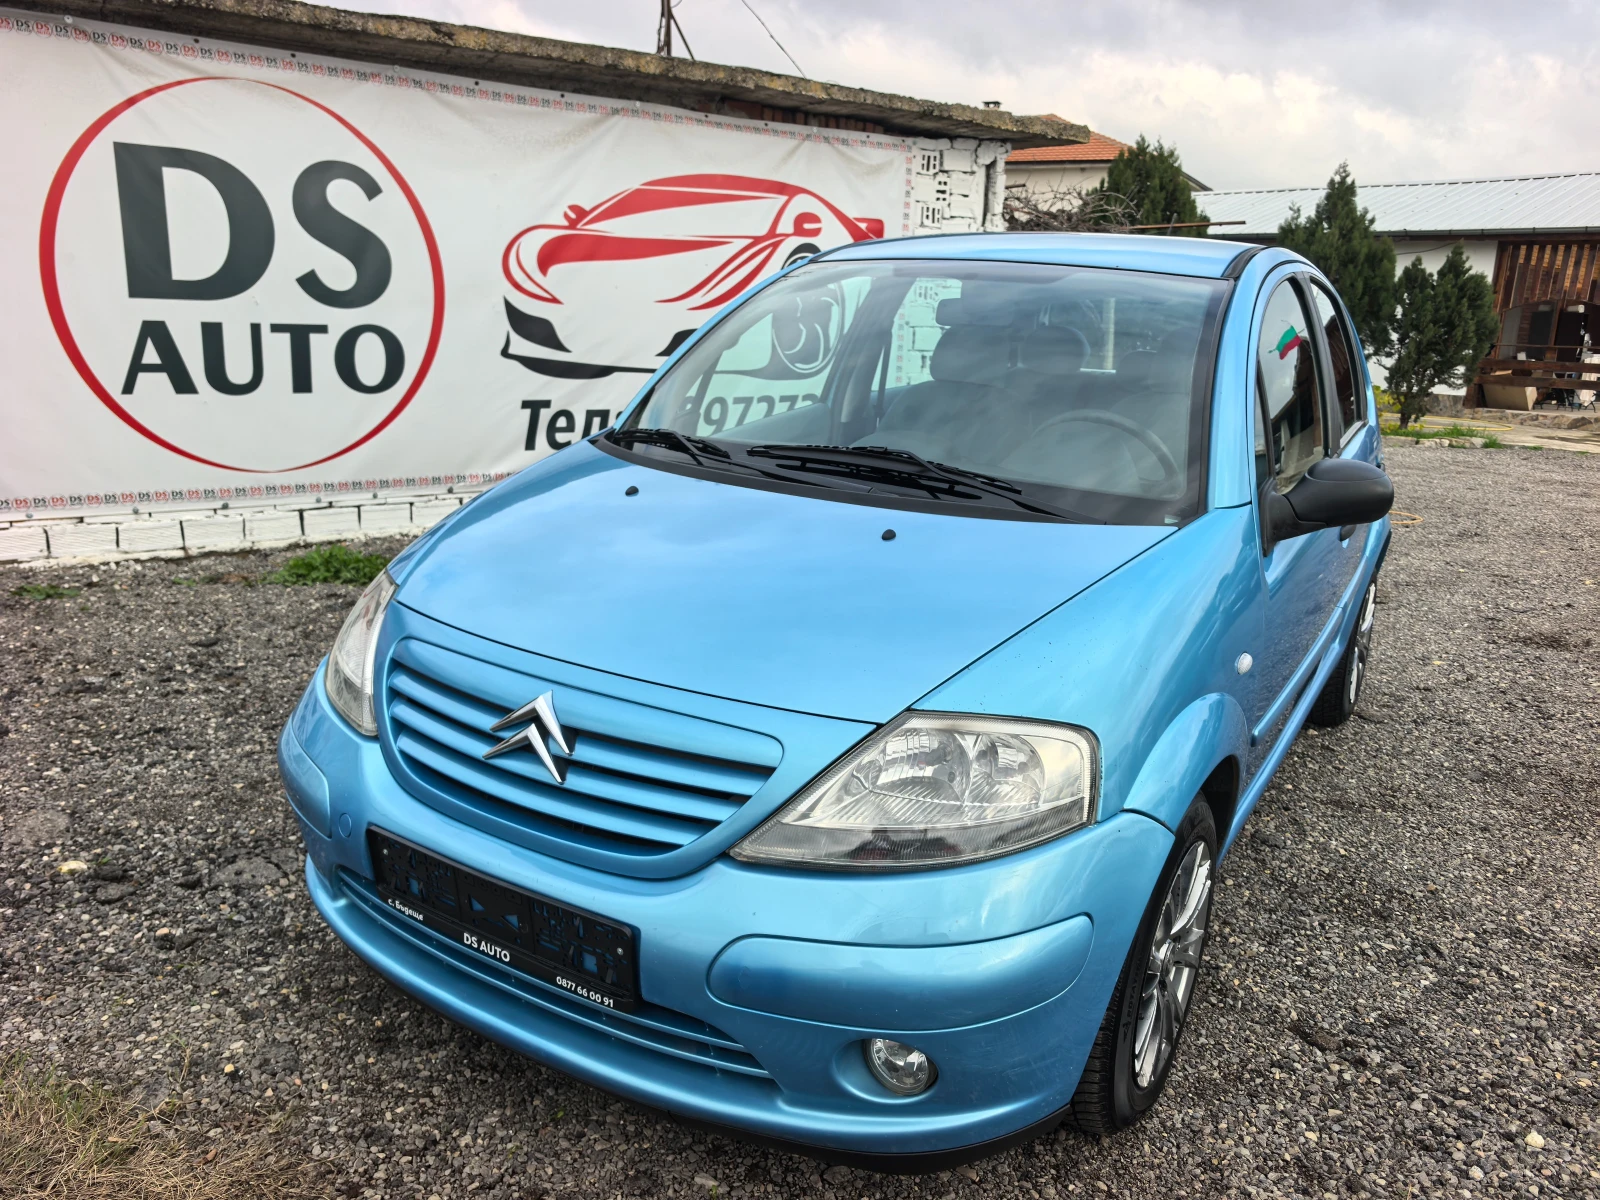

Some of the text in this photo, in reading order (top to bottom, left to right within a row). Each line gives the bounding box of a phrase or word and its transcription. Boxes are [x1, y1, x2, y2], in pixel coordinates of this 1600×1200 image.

[113, 141, 392, 309] DS
[121, 320, 405, 396] AUTO
[396, 900, 424, 920] Бъдеще
[464, 932, 510, 962] DS AUTO
[556, 976, 614, 1008] 0877 66 00 91
